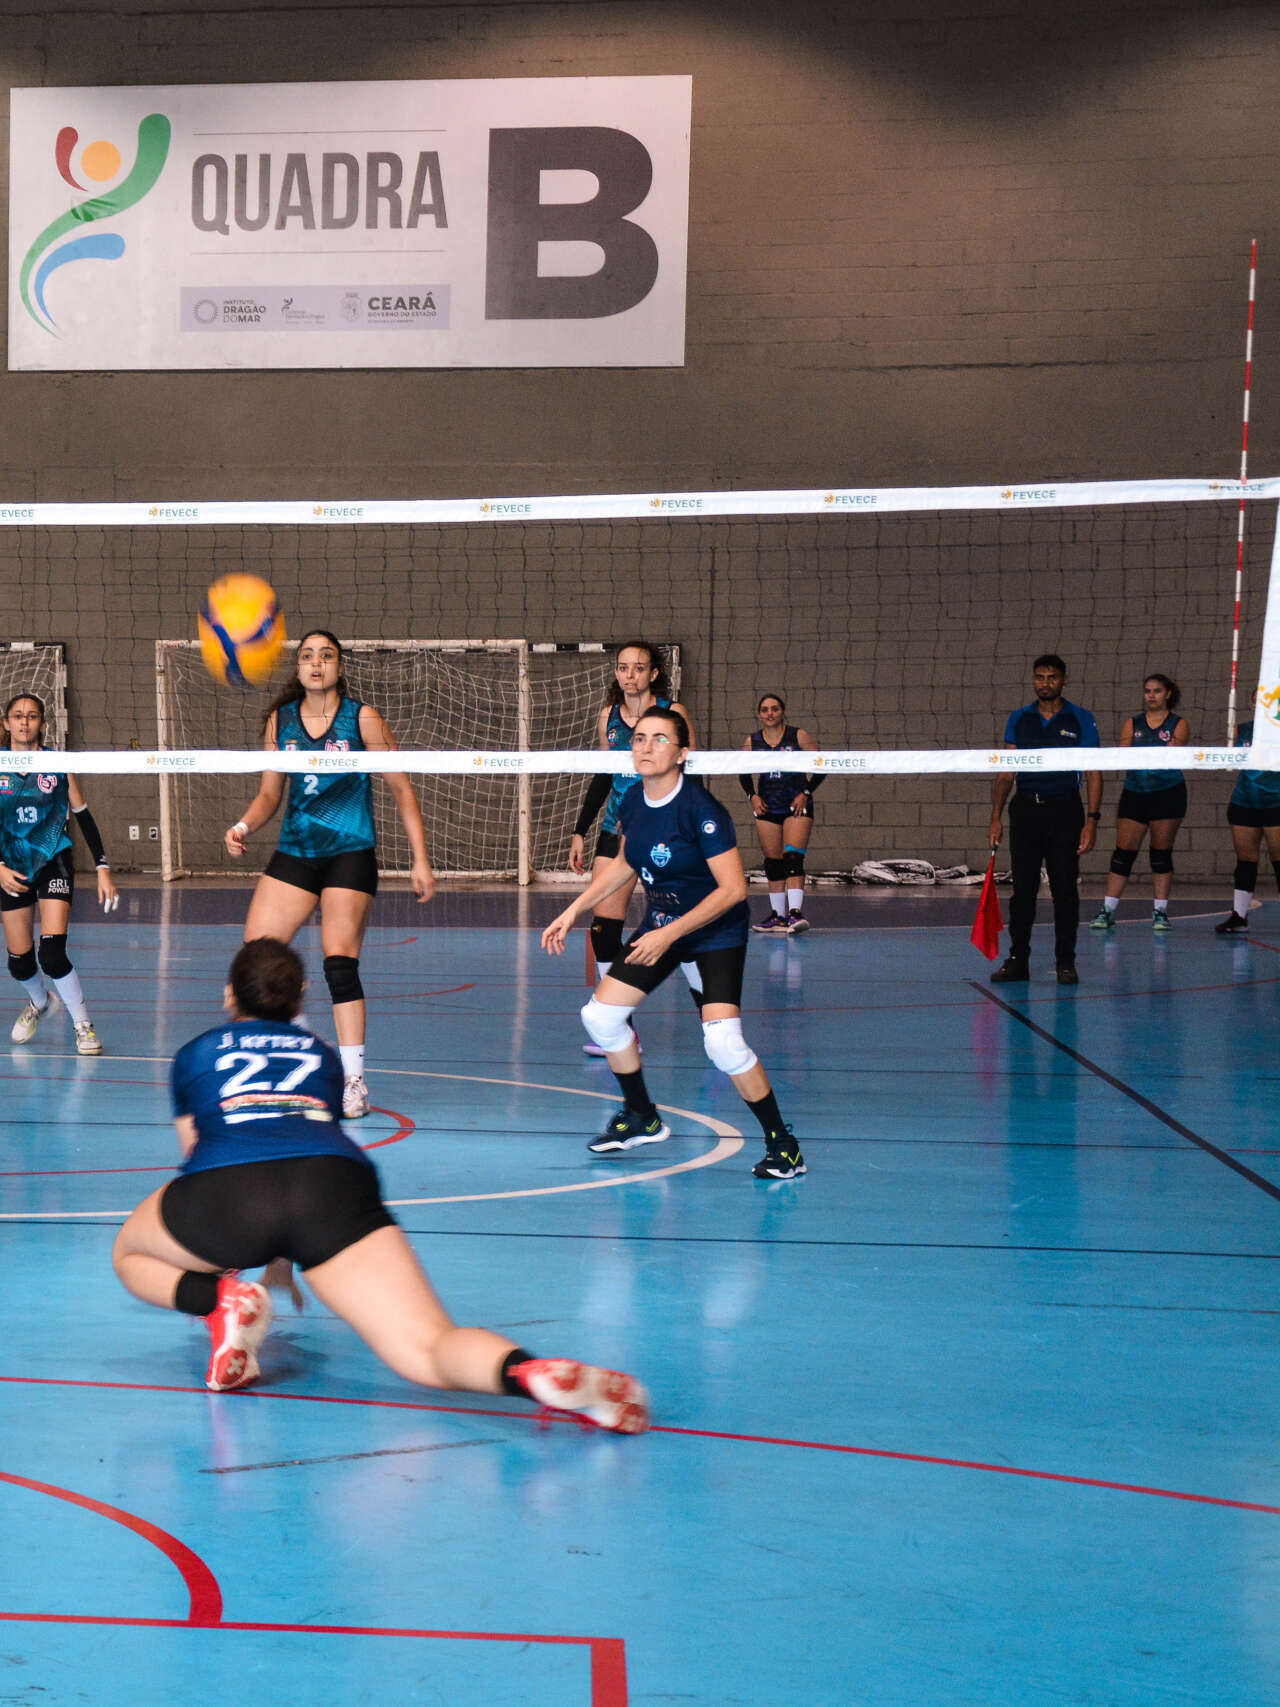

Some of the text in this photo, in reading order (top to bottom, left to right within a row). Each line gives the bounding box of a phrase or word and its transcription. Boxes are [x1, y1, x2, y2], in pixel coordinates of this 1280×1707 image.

[191, 151, 449, 235] QUADRA
[484, 126, 660, 321] B
[367, 291, 437, 311] CEARÁ
[411, 310, 437, 318] ESTADO
[1013, 489, 1056, 500] FEVECE
[662, 499, 703, 509] FEVECE
[836, 495, 877, 505] FEVECE
[159, 508, 199, 518] FEVECE
[323, 507, 363, 517] FEVECE
[490, 503, 531, 513] FEVECE
[156, 757, 195, 766] FEVECE
[318, 758, 358, 767] FEVECE
[999, 755, 1043, 765] FEVECE
[1205, 752, 1249, 763] FEVECE
[483, 758, 524, 768] FEVECE
[824, 758, 866, 768] FEVECE
[303, 774, 319, 795] 2
[16, 806, 38, 824] 13
[641, 867, 654, 884] 4
[215, 1051, 322, 1098] 27
